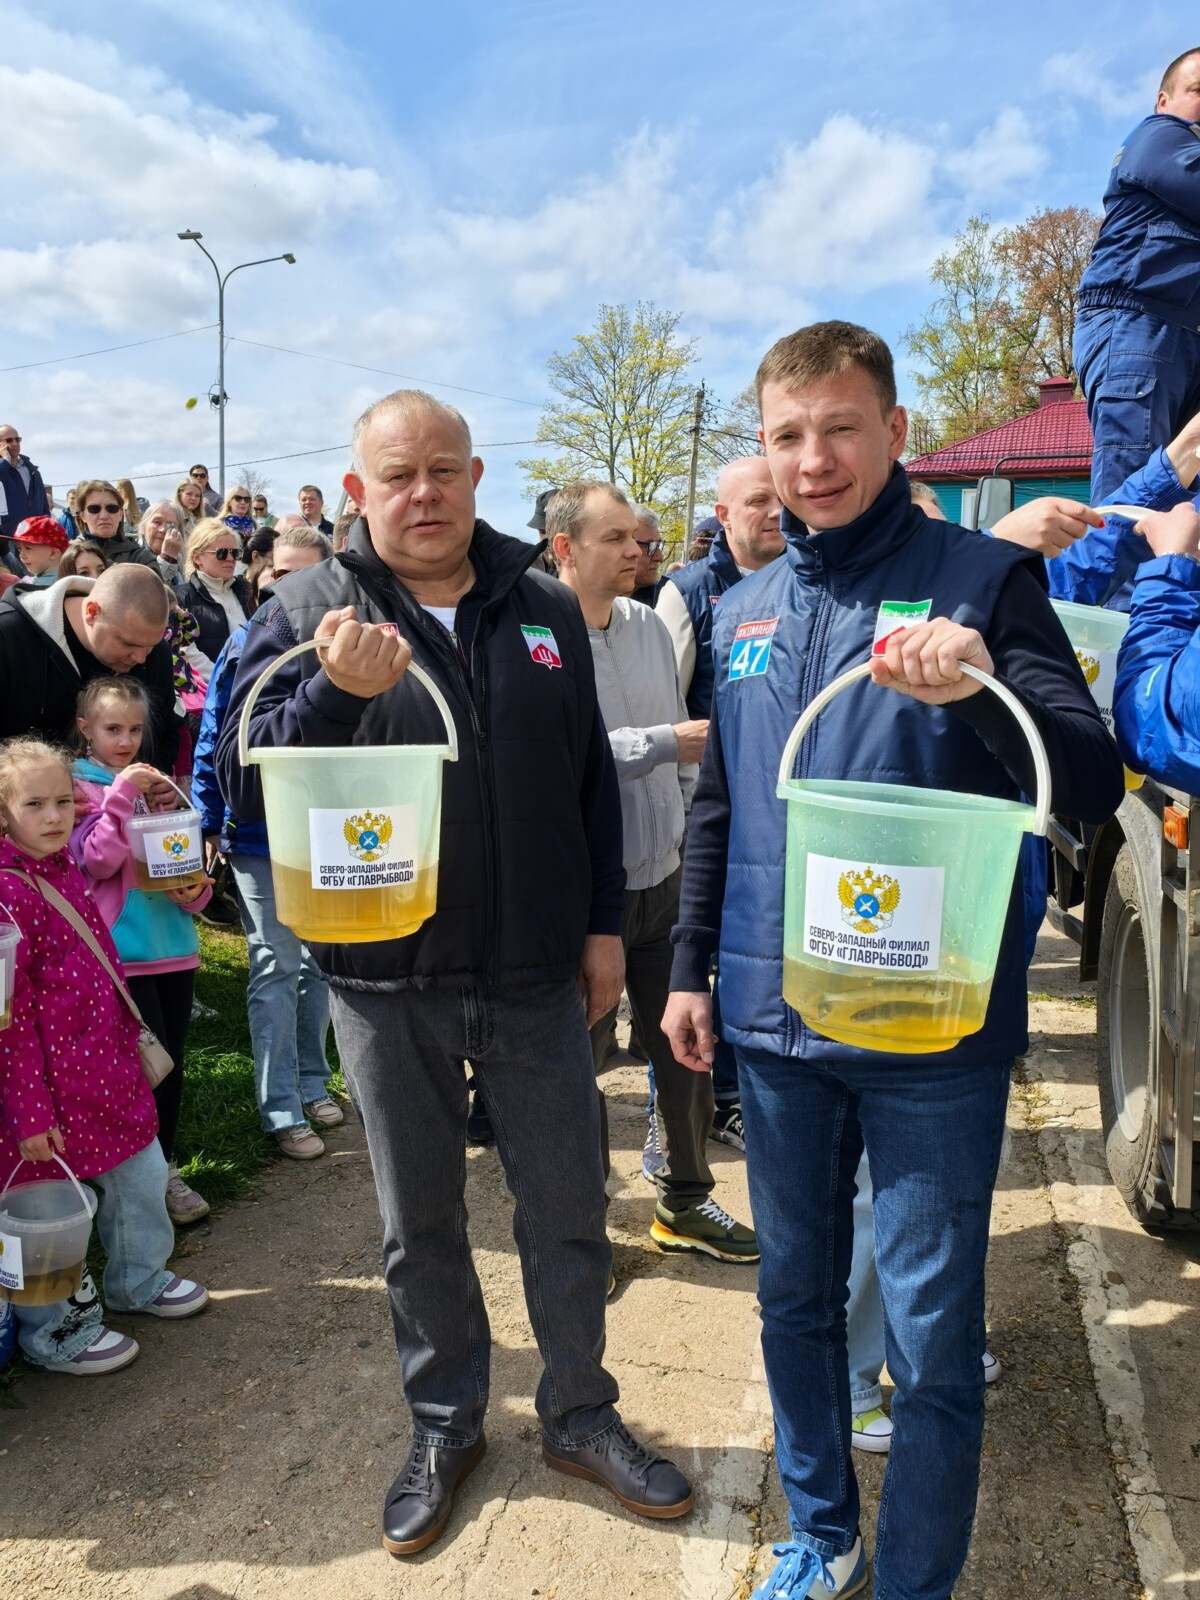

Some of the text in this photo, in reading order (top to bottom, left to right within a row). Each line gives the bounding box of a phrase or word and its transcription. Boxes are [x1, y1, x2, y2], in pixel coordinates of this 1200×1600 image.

[732, 638, 770, 676] 47
[319, 859, 414, 874] СЕВЕРО-ЗАПАДНЫЙ ФИЛИАЛ
[320, 871, 414, 886] ФГБУ «ГЛАВРЫБВОД»
[809, 925, 930, 952] СЕВЕРО-ЗАПАДНЫЙ ФИЛИАЛ
[809, 938, 929, 969] ФГБУ «ГЛАВРЫБВОД»
